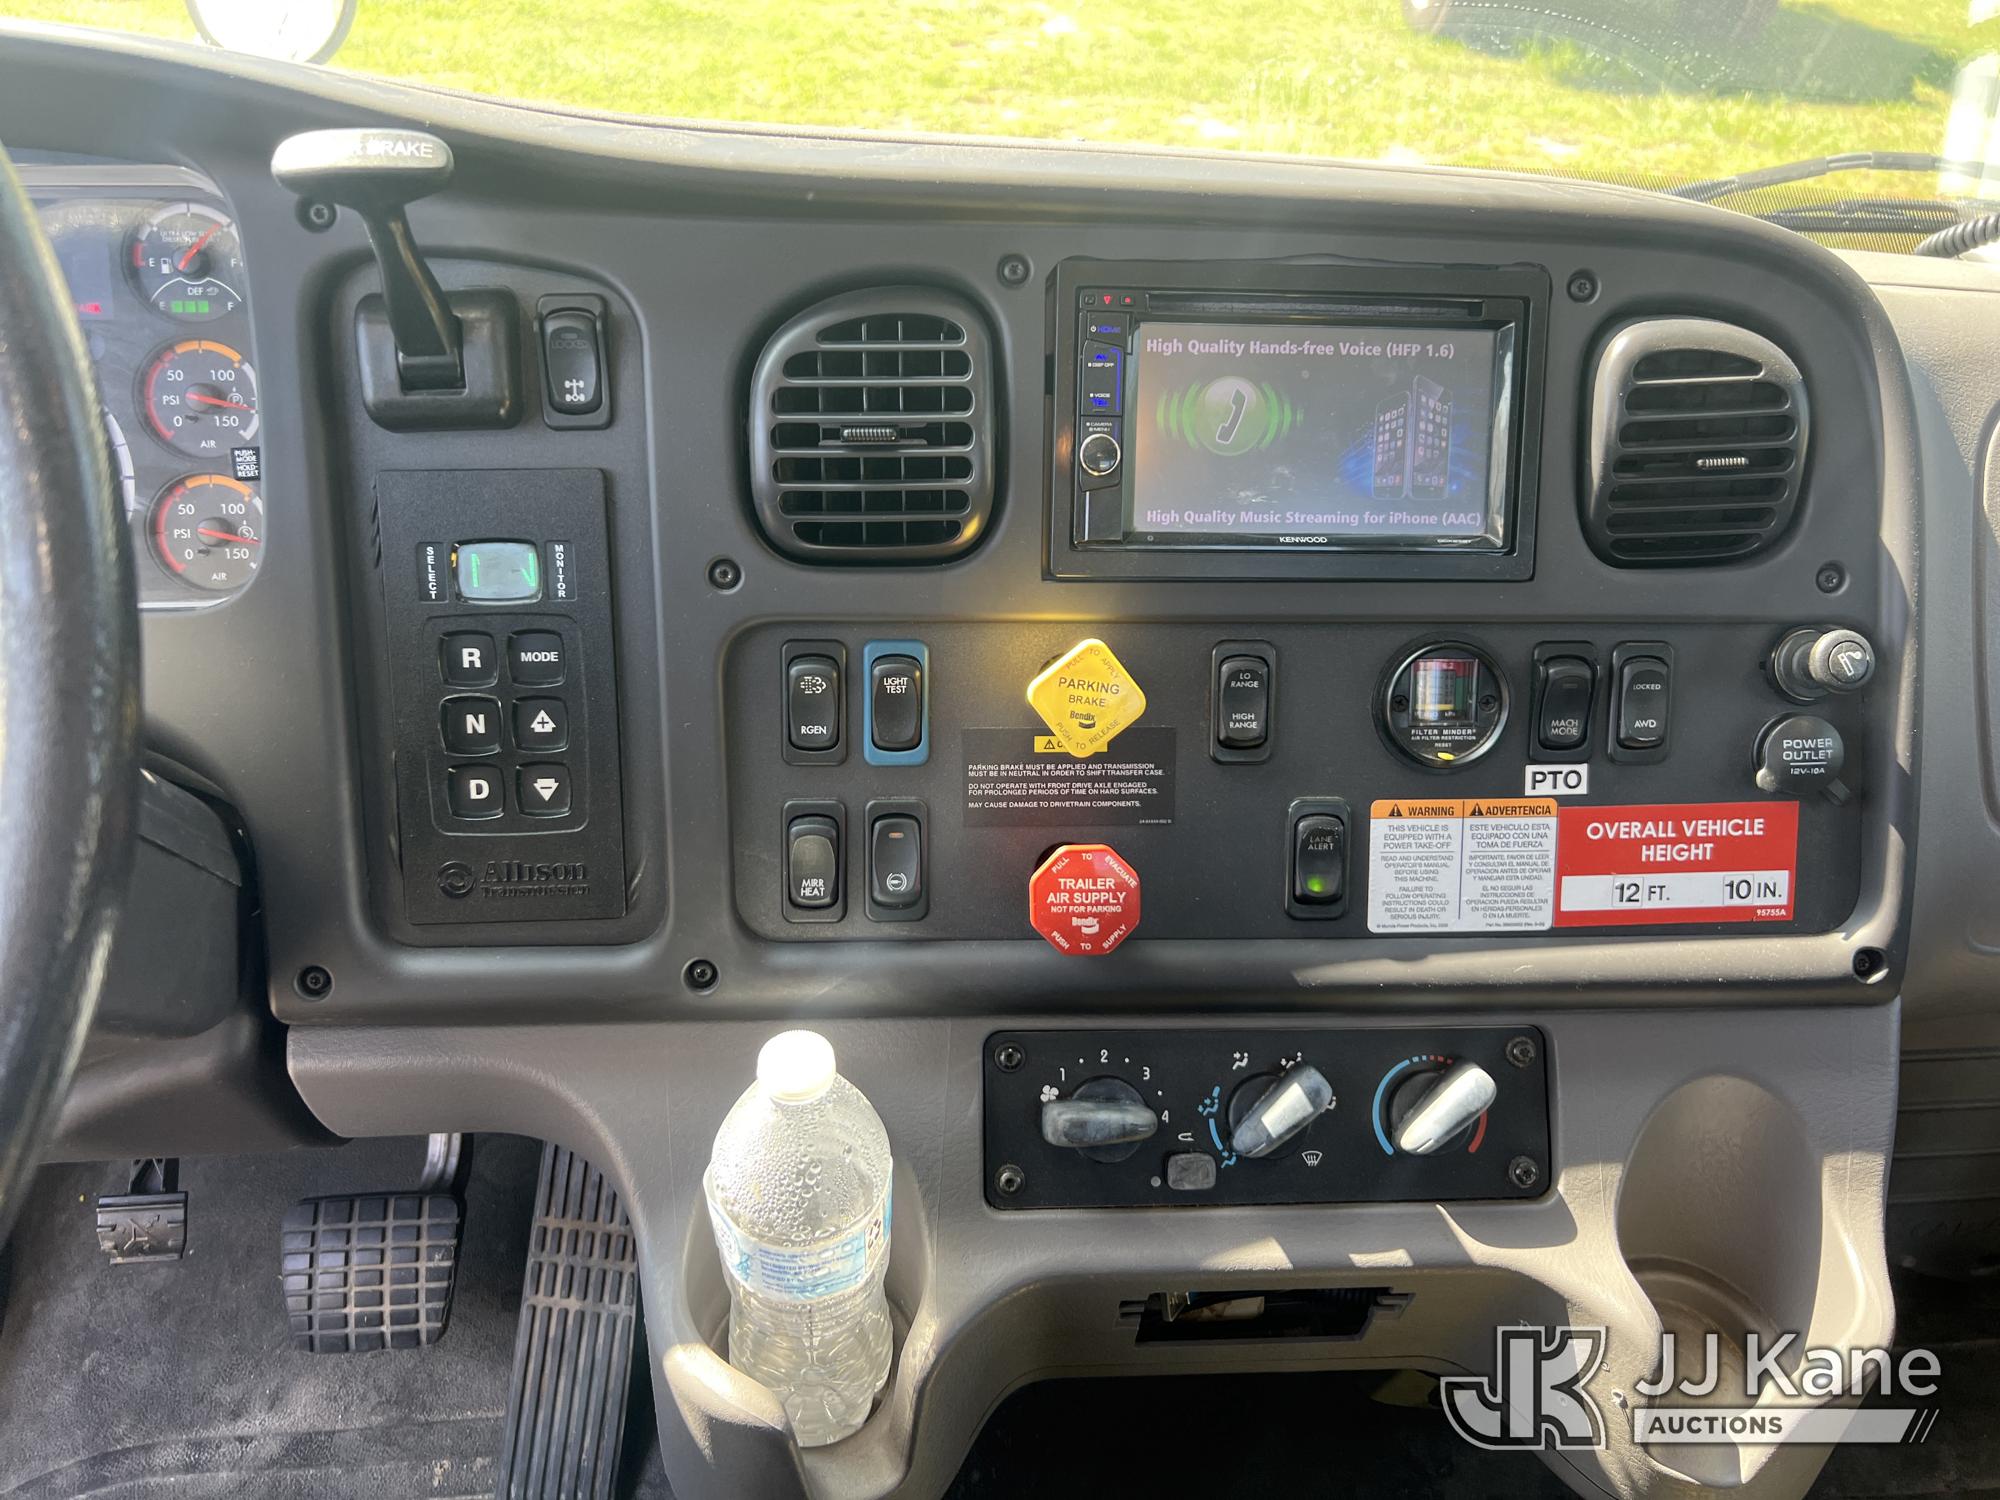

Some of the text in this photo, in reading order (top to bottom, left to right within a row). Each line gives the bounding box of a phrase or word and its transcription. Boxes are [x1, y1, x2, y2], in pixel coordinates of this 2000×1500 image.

[149, 258, 155, 267] E
[231, 259, 237, 268] F
[187, 287, 203, 295] DEF
[227, 302, 234, 311] F
[1146, 338, 1454, 359] High Quality Hands-free Voice (HFP 1.6)
[168, 370, 235, 381] 50 100
[163, 395, 179, 405] PSI
[173, 416, 239, 427] 0 150
[200, 440, 216, 448] AIR
[178, 504, 245, 515] 50 100
[1146, 509, 1481, 526] High Quality Music Streaming for iPhone (AAC)
[174, 529, 191, 538] PSI
[184, 548, 249, 560] 0 150
[211, 573, 227, 581] AIR
[426, 547, 437, 600] SELECT
[554, 545, 566, 598] MONITOR
[462, 648, 481, 668] R
[521, 652, 559, 662] MODE
[1089, 648, 1100, 656] TO
[1102, 657, 1120, 679] APPLY
[884, 678, 908, 686] LIGHT
[1058, 677, 1120, 695] PARKING
[886, 686, 906, 694] TEST
[1069, 694, 1106, 708] BRAKE
[1070, 711, 1095, 721] Bendix
[466, 714, 486, 734] N
[1229, 721, 1258, 729] RANGE
[1551, 719, 1579, 727] MACH
[1634, 719, 1657, 728] AWD
[801, 725, 827, 734] RGEN
[1056, 722, 1073, 741] PUSH
[1076, 742, 1086, 750] TO
[1089, 720, 1120, 745] RELEASE
[1551, 727, 1579, 736] MODE
[1783, 738, 1833, 749] POWER
[1782, 750, 1834, 761] OUTLET
[1790, 767, 1825, 775] 12V-10A
[1531, 770, 1582, 790] PTO
[469, 779, 490, 799] D
[1408, 806, 1455, 816] WARNING
[1485, 805, 1552, 816] ADVERTENCIA
[1407, 824, 1439, 832] VEHICLE
[1531, 823, 1550, 831] ESTA
[1587, 818, 1765, 840] OVERALL VEHICLE
[1310, 835, 1332, 843] LANE
[1383, 833, 1423, 841] EQUIPPED
[1383, 841, 1452, 850] POWER TAKE-OFF
[1641, 843, 1714, 862] HEIGHT
[480, 860, 585, 881] Allison
[1051, 856, 1070, 874] PULL
[1104, 855, 1138, 888] EVACUATE
[802, 879, 824, 888] MIRR
[1058, 878, 1115, 889] TRAILER
[801, 888, 825, 896] HEAT
[1615, 880, 1783, 903] 12 FT. 10 IN.
[1046, 892, 1127, 904] AIR SUPPLY
[1051, 905, 1122, 913] NOT FOR PARKING
[1051, 930, 1070, 950] PUSH
[1102, 923, 1128, 949] SUPPLY
[1100, 1049, 1109, 1063] 2
[1059, 1067, 1066, 1081] 1
[1142, 1066, 1151, 1080] 3
[1161, 1110, 1170, 1124] 4
